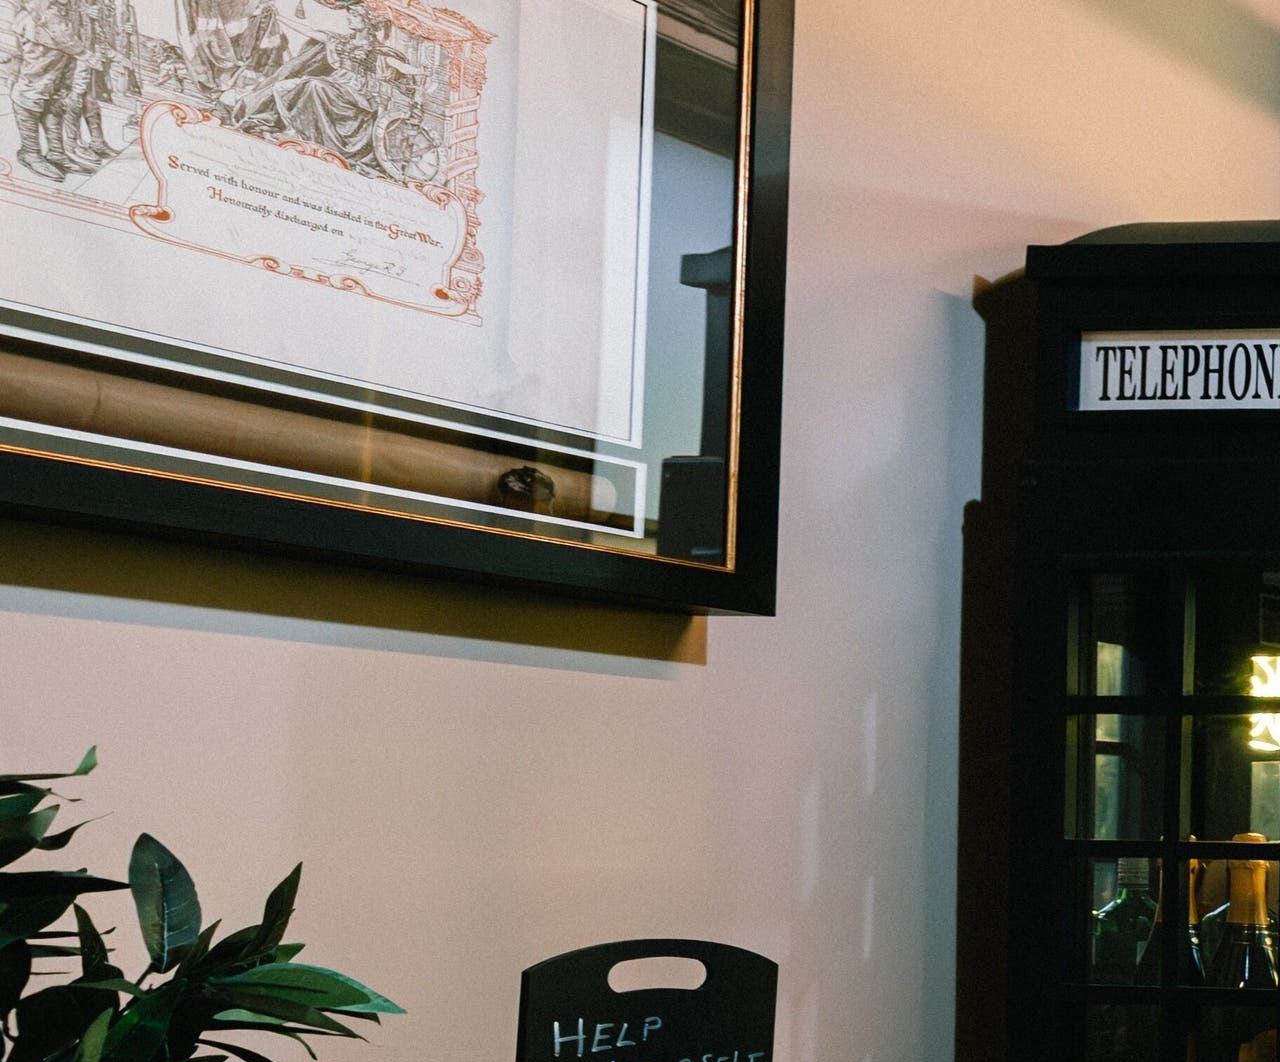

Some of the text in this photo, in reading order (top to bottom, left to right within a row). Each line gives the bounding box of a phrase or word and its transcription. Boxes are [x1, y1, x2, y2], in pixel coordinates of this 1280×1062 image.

[167, 154, 210, 178] Served
[213, 173, 238, 187] with
[241, 179, 280, 199] honour
[282, 195, 301, 206] and
[302, 201, 323, 212] was
[324, 206, 362, 223] disabled
[363, 217, 374, 227] in
[375, 221, 388, 231] the
[388, 224, 418, 240] Great
[206, 186, 272, 218] Honourably
[274, 210, 329, 232] discharged
[552, 1016, 663, 1058] HELP
